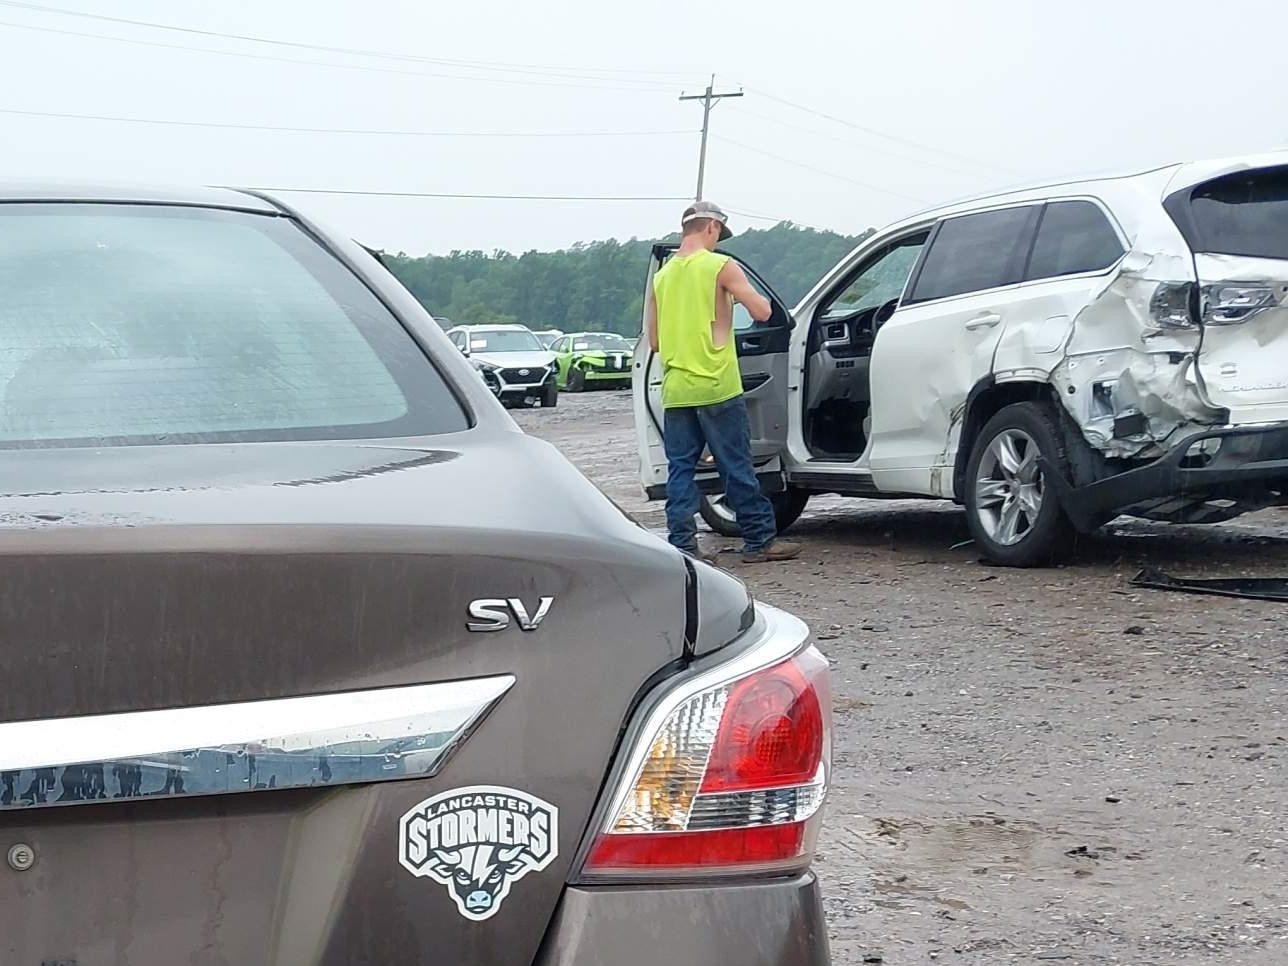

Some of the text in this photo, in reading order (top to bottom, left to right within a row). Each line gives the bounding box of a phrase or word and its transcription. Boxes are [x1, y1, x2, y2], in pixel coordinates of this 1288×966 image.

[465, 596, 554, 632] SV
[426, 794, 530, 820] LANCASTER
[408, 808, 548, 866] STORMERS
